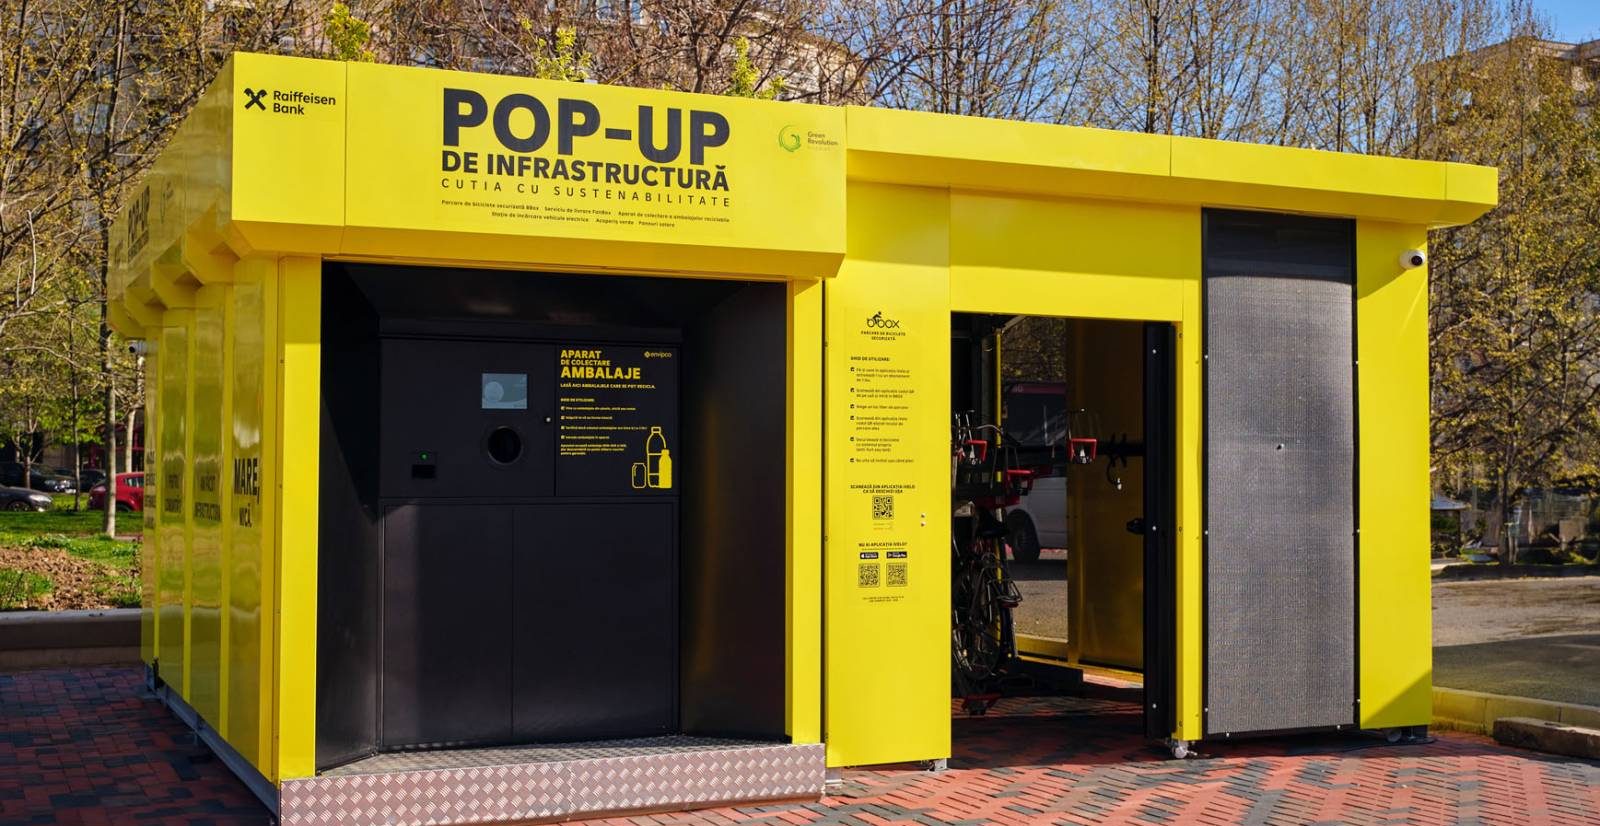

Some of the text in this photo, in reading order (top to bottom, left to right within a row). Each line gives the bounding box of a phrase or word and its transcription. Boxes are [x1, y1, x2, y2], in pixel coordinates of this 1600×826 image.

[273, 90, 336, 105] Raiffeisen
[273, 102, 304, 115] Bank
[443, 88, 730, 166] POP-UP
[442, 150, 730, 191] DE INFRASTRUCTURĂ
[442, 178, 730, 207] CUTIA CU SUSTENABILITATE
[560, 350, 602, 359] APARAT
[560, 366, 640, 380] AMBALAJE
[234, 458, 260, 504] MARE,
